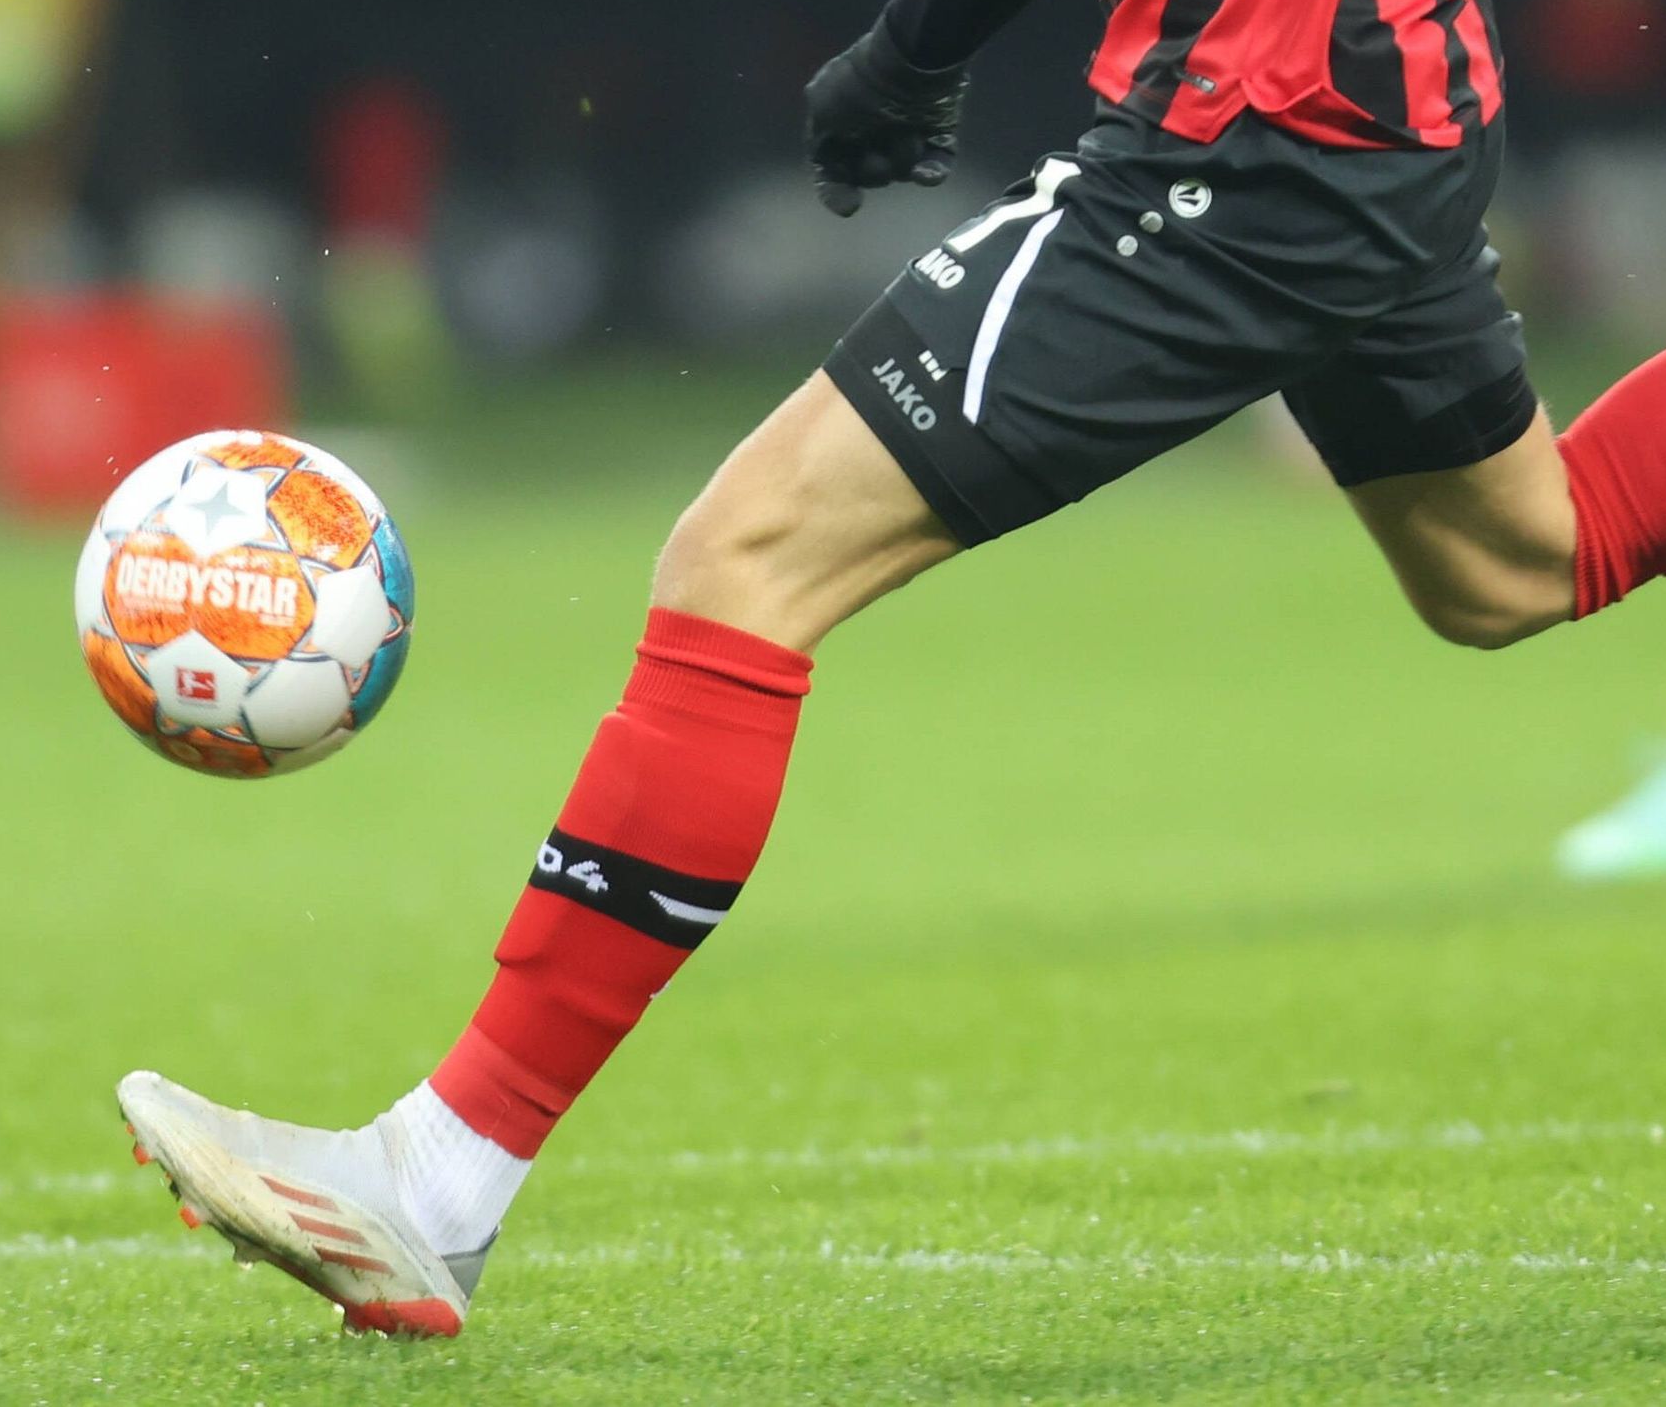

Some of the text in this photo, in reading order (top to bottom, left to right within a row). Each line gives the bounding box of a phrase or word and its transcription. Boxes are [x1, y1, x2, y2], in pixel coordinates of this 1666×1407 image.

[914, 247, 966, 289] AKO
[871, 357, 937, 431] JAKO
[116, 553, 297, 617] DERBYSTAR
